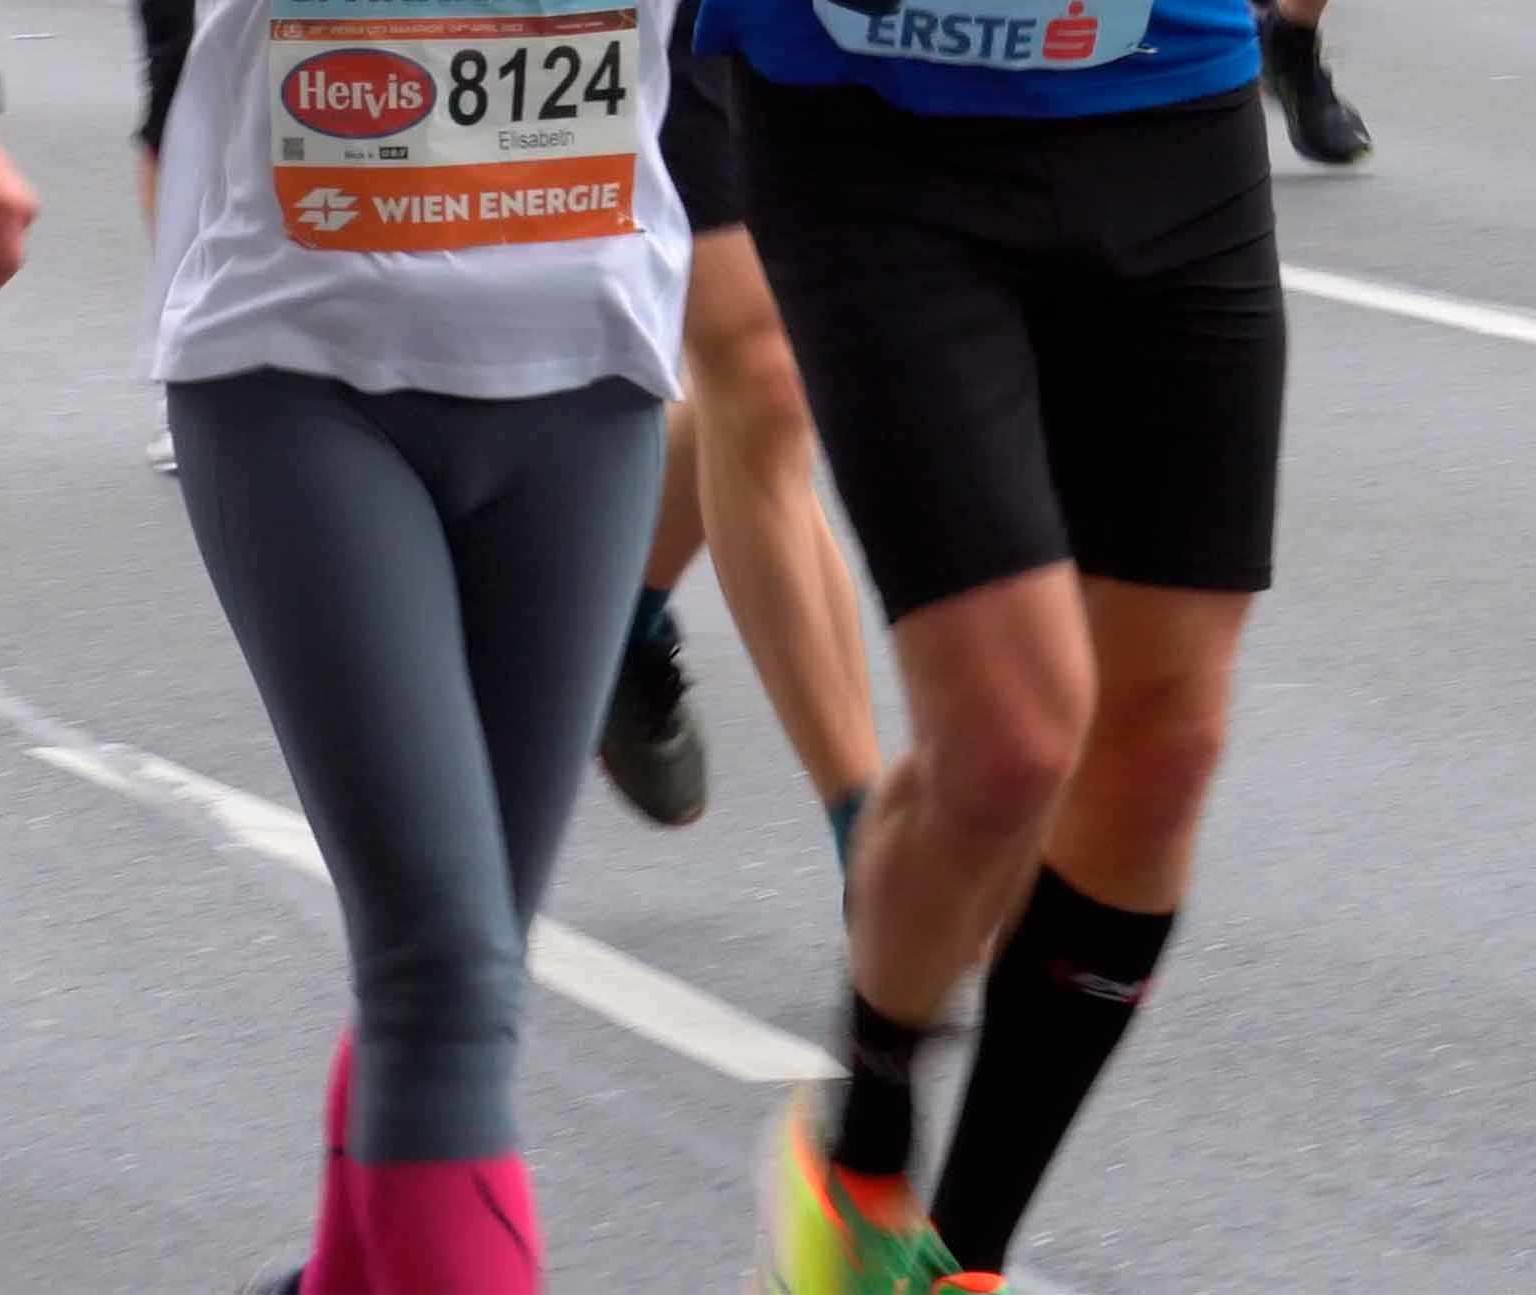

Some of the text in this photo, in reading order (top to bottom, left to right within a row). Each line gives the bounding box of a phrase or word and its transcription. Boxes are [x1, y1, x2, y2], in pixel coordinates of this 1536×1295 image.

[867, 7, 1037, 60] ERSTE
[297, 41, 627, 127] Hervis 8124
[373, 182, 621, 225] WIEN ENERGIE
